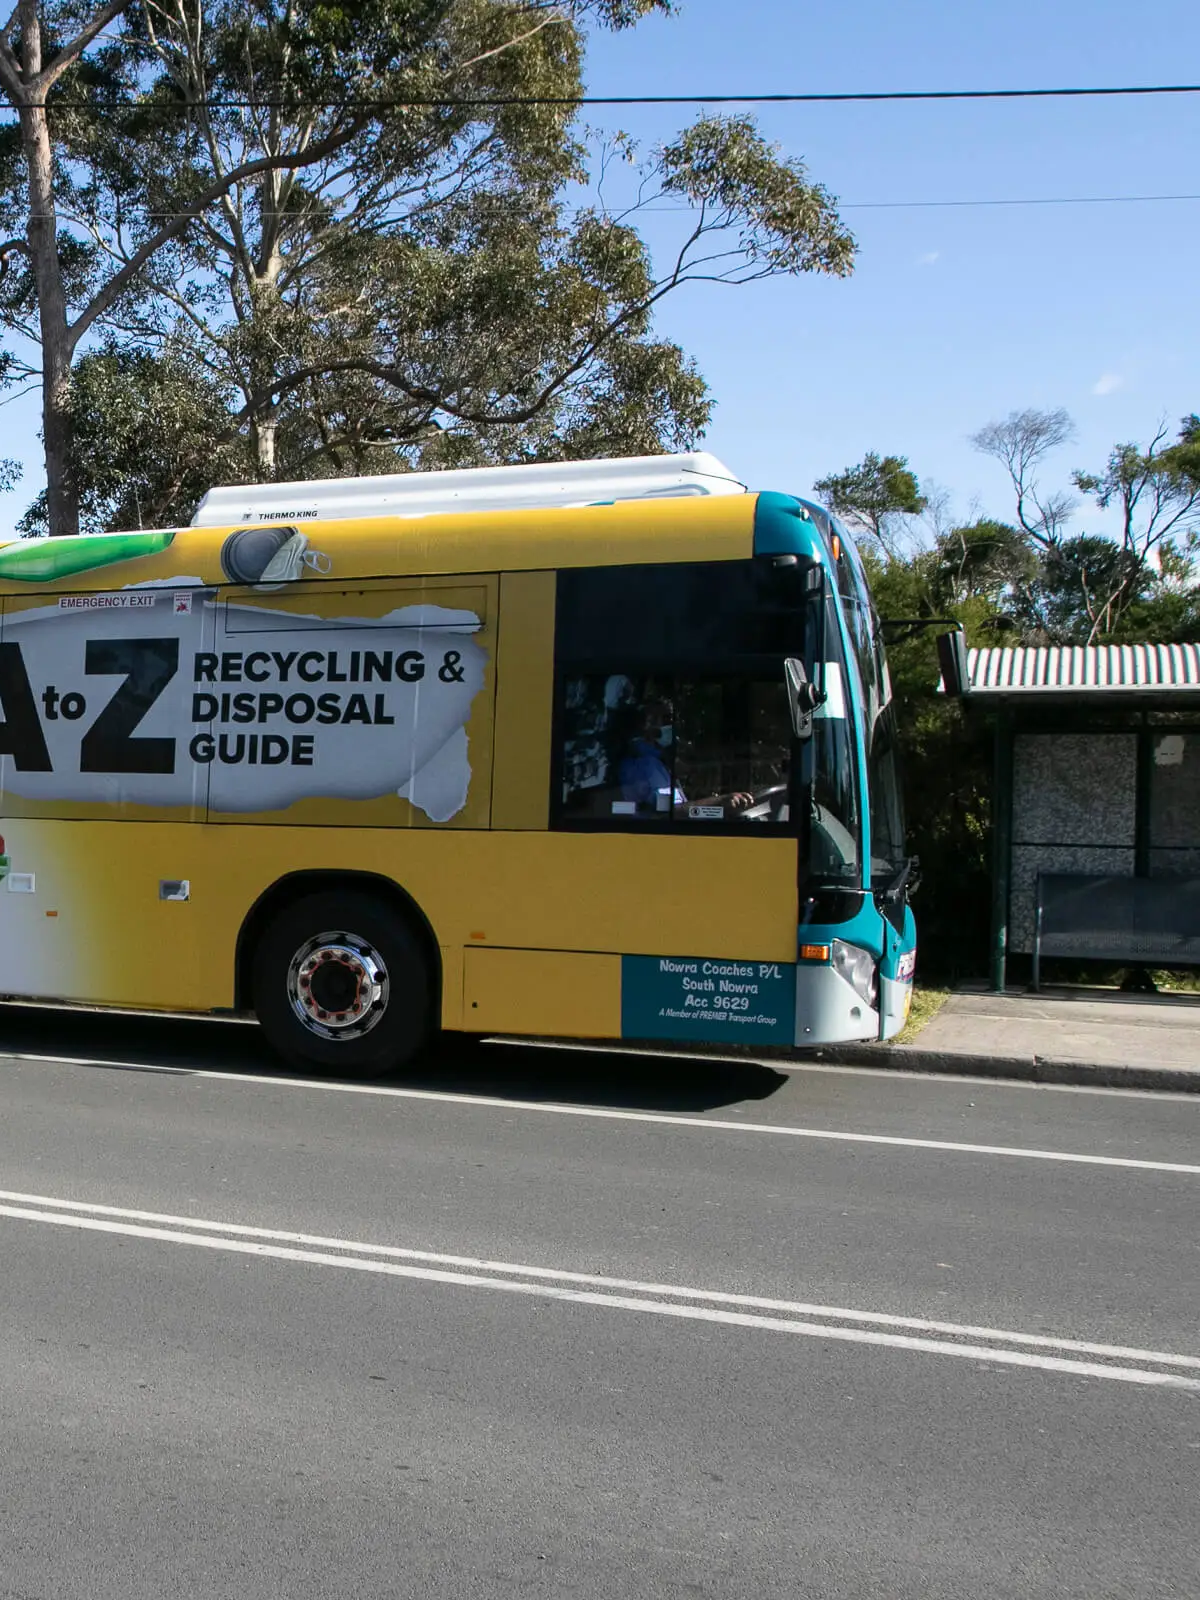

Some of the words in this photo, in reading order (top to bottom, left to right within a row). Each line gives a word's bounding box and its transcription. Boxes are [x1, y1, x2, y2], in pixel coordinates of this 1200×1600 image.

[259, 511, 296, 520] THERMO
[296, 510, 318, 518] KING
[60, 596, 128, 608] EMERGENCY
[130, 595, 154, 606] EXIT
[193, 650, 425, 683] RECYCLING
[437, 650, 466, 683] &
[42, 685, 87, 721] to
[80, 637, 180, 774] Z
[191, 693, 395, 725] DISPOSAL
[188, 733, 315, 766] GUIDE
[659, 959, 698, 974] Nowra
[702, 961, 754, 977] Coaches
[759, 964, 782, 980] P/L
[681, 976, 715, 992] South
[719, 980, 759, 995] Nowra
[684, 994, 709, 1008] Acc
[713, 996, 750, 1010] 9629
[659, 1008, 665, 1017] A
[665, 1008, 692, 1018] Member
[691, 1010, 700, 1019] of
[699, 1010, 728, 1021] PREMIER
[728, 1012, 757, 1024] Transport
[757, 1014, 777, 1026] Group
